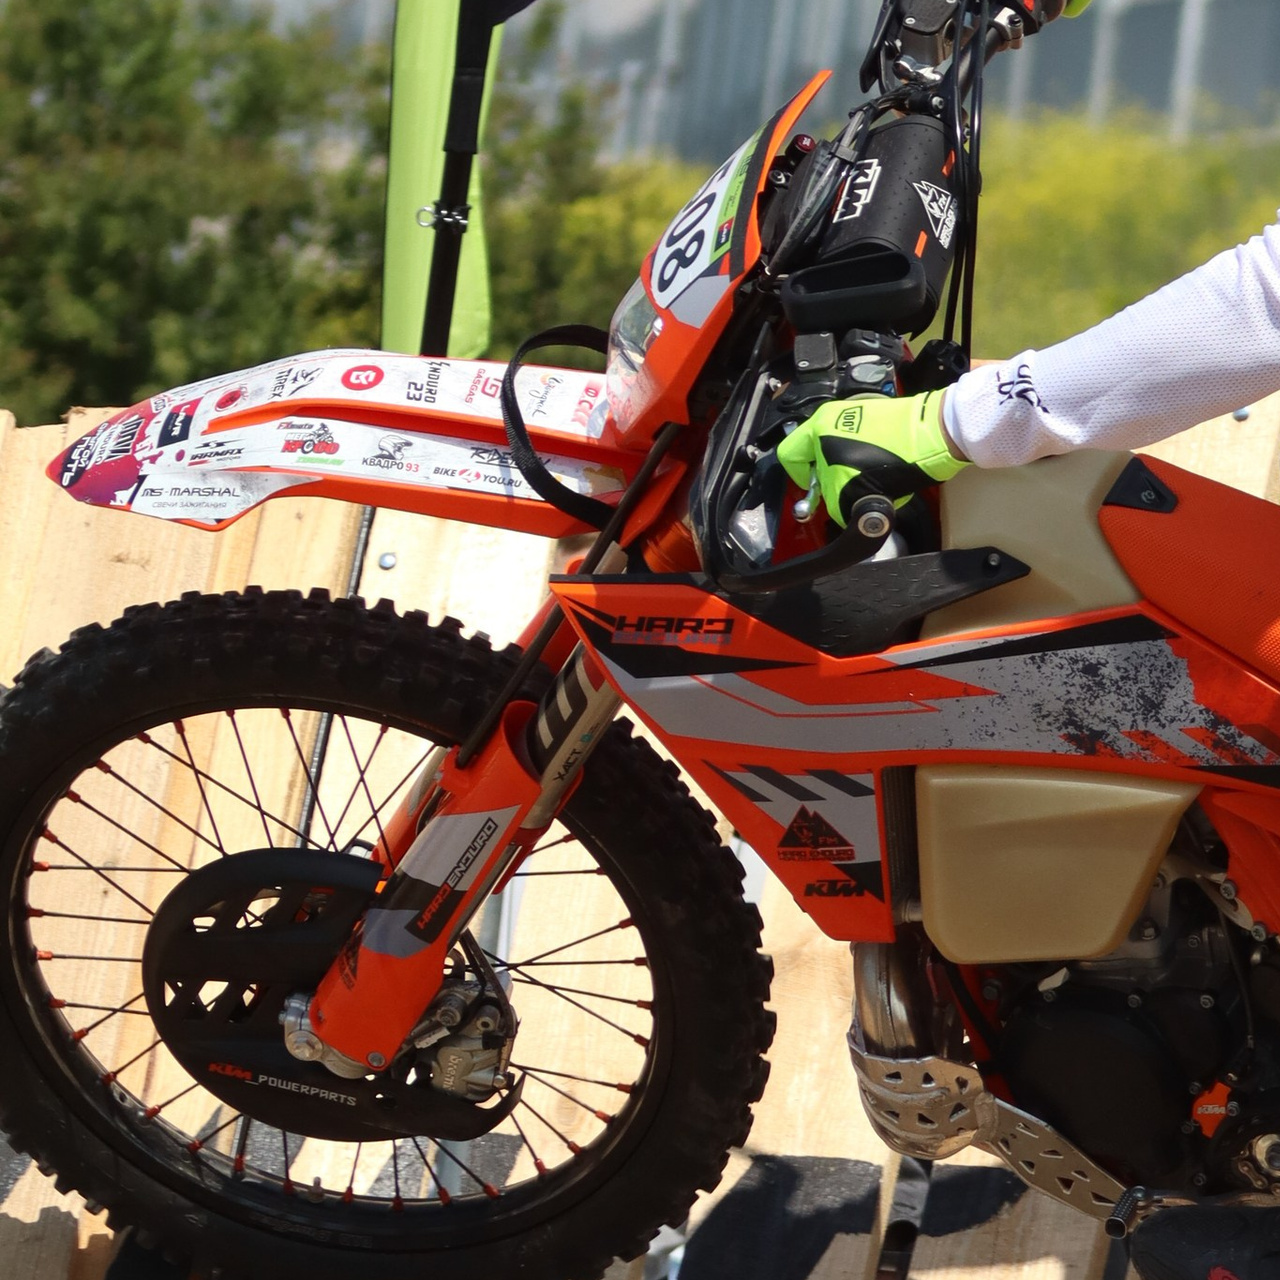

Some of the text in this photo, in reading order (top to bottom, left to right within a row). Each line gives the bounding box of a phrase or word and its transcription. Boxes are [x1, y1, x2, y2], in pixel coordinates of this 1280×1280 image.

[407, 381, 425, 402] 23
[465, 368, 486, 404] GASGAS
[362, 457, 419, 473] КВАДРО 93
[433, 466, 457, 477] BIKE
[483, 473, 522, 488] YOU.RU
[553, 749, 582, 780] XACT
[804, 879, 865, 897] KTM
[443, 1055, 462, 1090] brem
